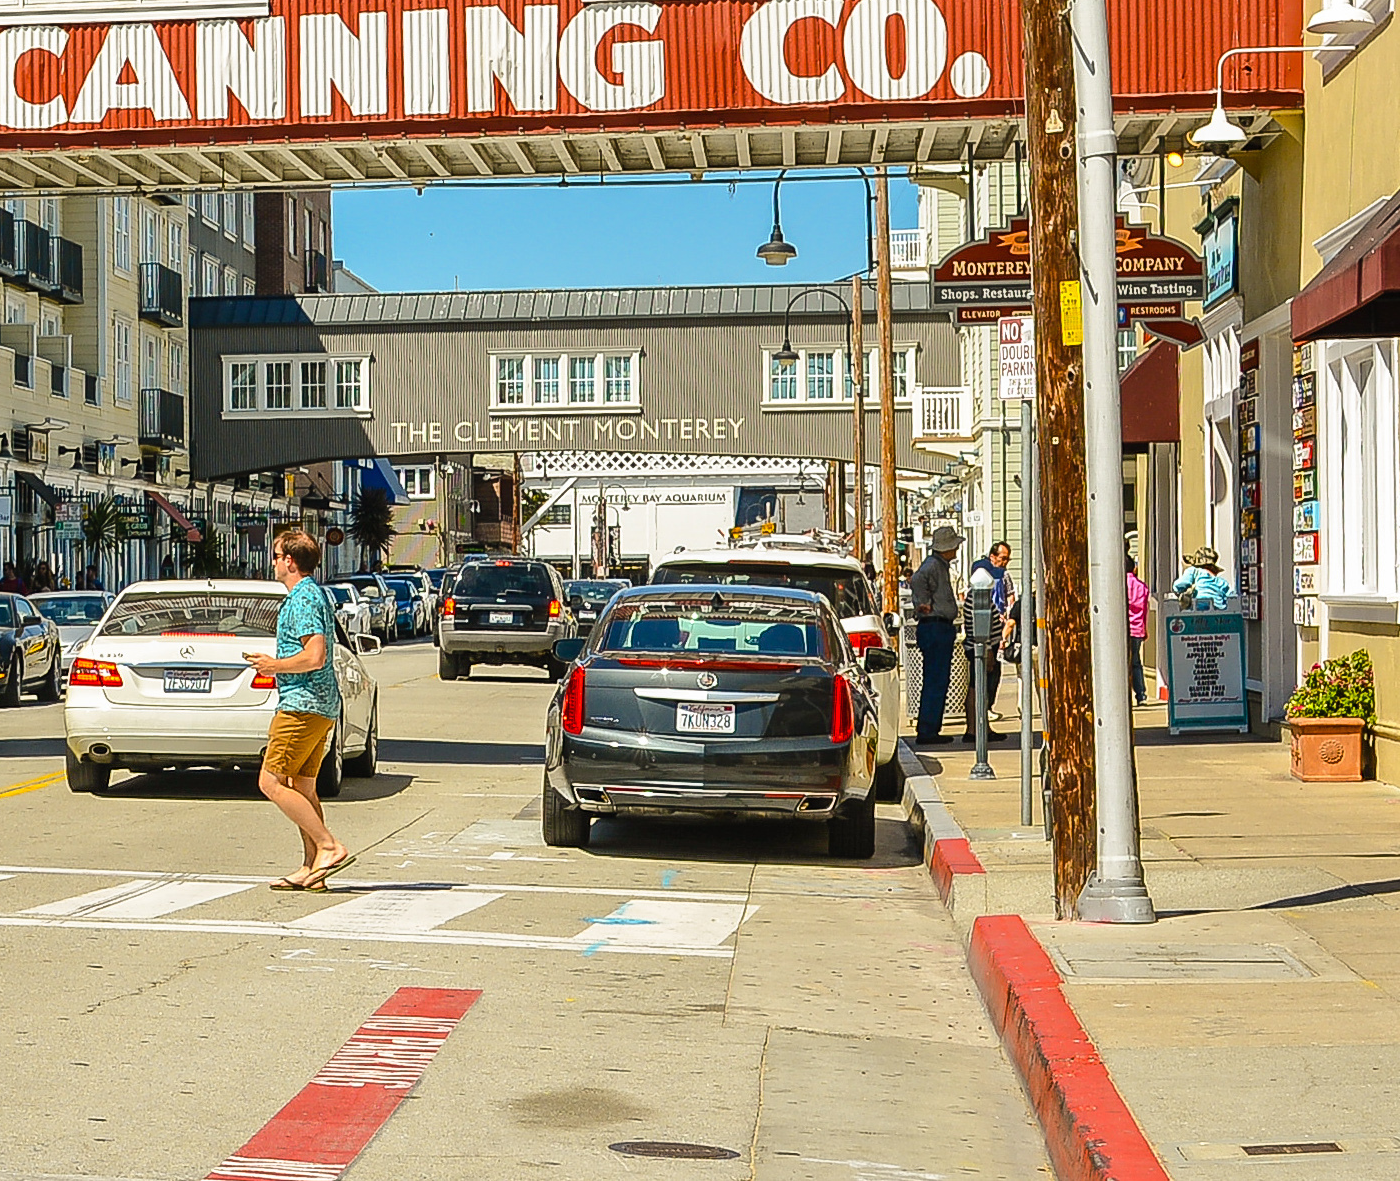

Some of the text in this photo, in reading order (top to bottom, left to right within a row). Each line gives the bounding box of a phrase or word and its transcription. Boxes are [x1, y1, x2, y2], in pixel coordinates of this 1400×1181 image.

[952, 260, 1031, 277] MONTEREY
[941, 288, 979, 301] Shops.
[1117, 284, 1148, 296] Wine
[1150, 283, 1197, 296] Tasting.
[961, 309, 1001, 319] ELEVATOR
[1130, 305, 1176, 315] RESTROOMS
[1001, 322, 1019, 340] NO
[391, 417, 746, 443] THE CLEMENT MONTEREY
[643, 494, 662, 502] BAY
[665, 493, 726, 502] AQUARIUM
[681, 714, 730, 728] 7KUN328
